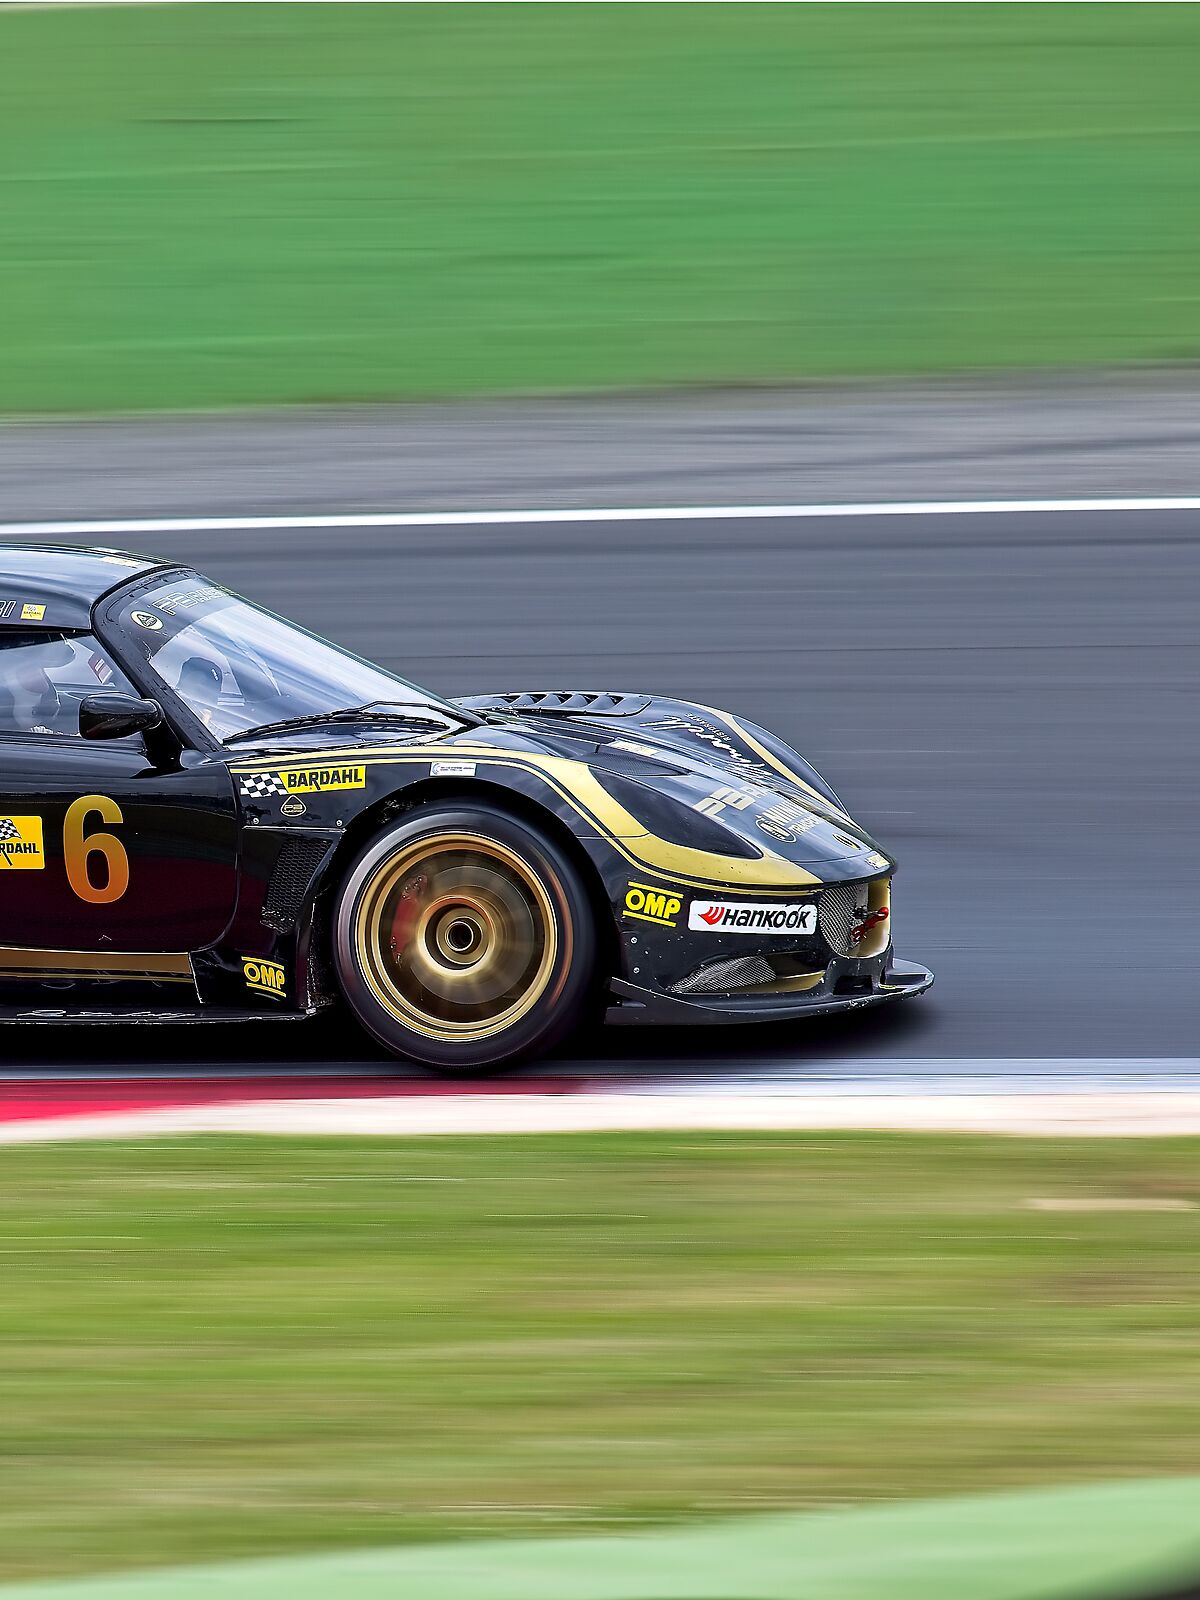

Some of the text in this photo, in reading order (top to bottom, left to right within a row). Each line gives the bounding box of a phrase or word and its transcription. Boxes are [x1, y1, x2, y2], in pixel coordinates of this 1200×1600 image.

[287, 768, 363, 791] BARDAHL
[63, 794, 130, 904] 6
[625, 889, 681, 919] OMP
[243, 962, 285, 990] OMP
